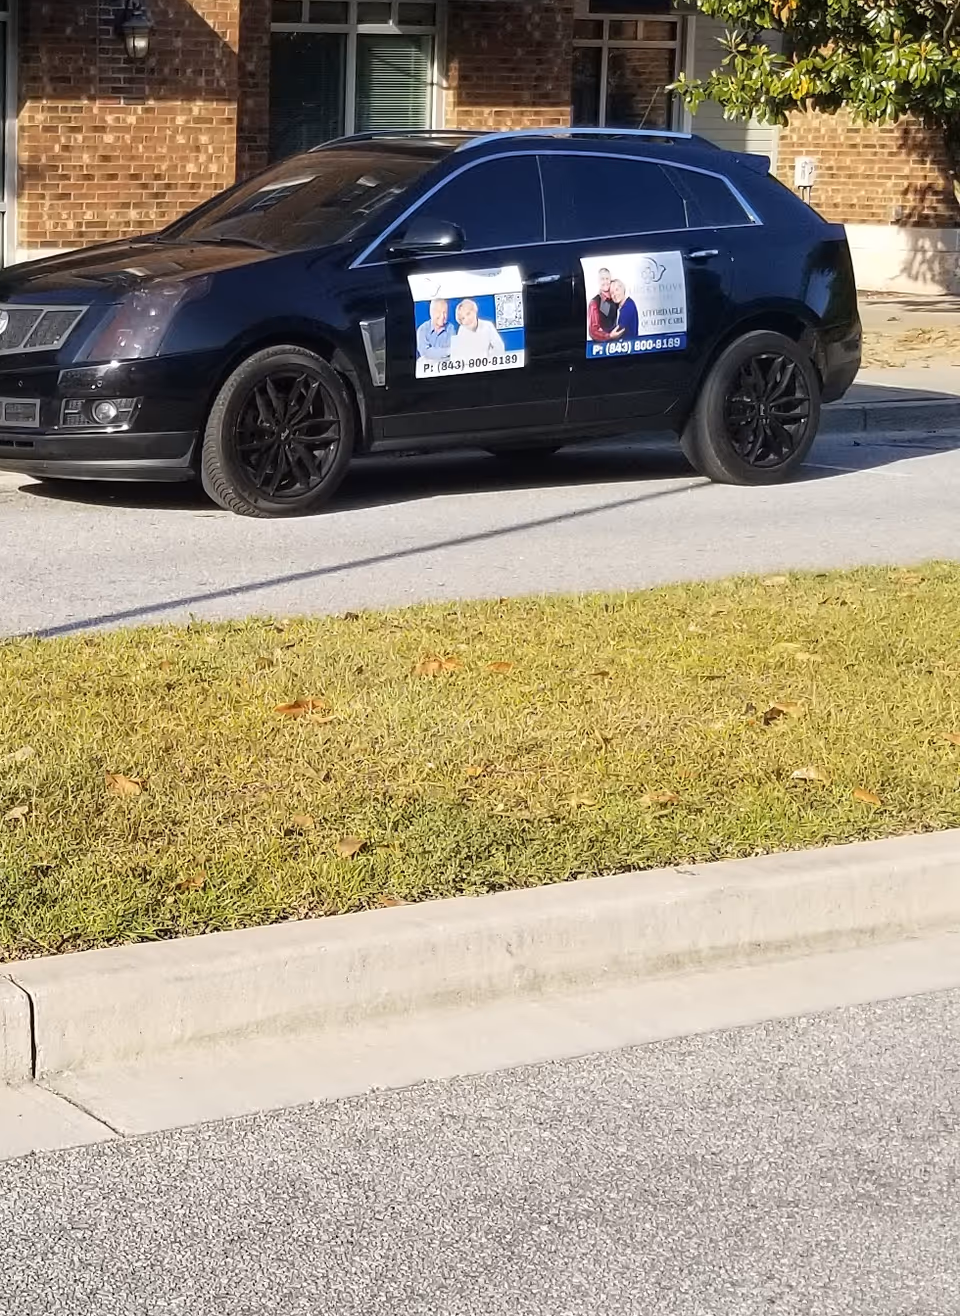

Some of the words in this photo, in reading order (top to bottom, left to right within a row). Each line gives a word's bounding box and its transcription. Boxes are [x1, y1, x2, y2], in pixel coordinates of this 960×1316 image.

[592, 344, 603, 355] P:
[605, 341, 632, 356] (843)
[634, 338, 681, 351] 800-8189
[423, 363, 433, 373] P:
[437, 360, 465, 373] (843)
[468, 354, 518, 368] 800-8189
